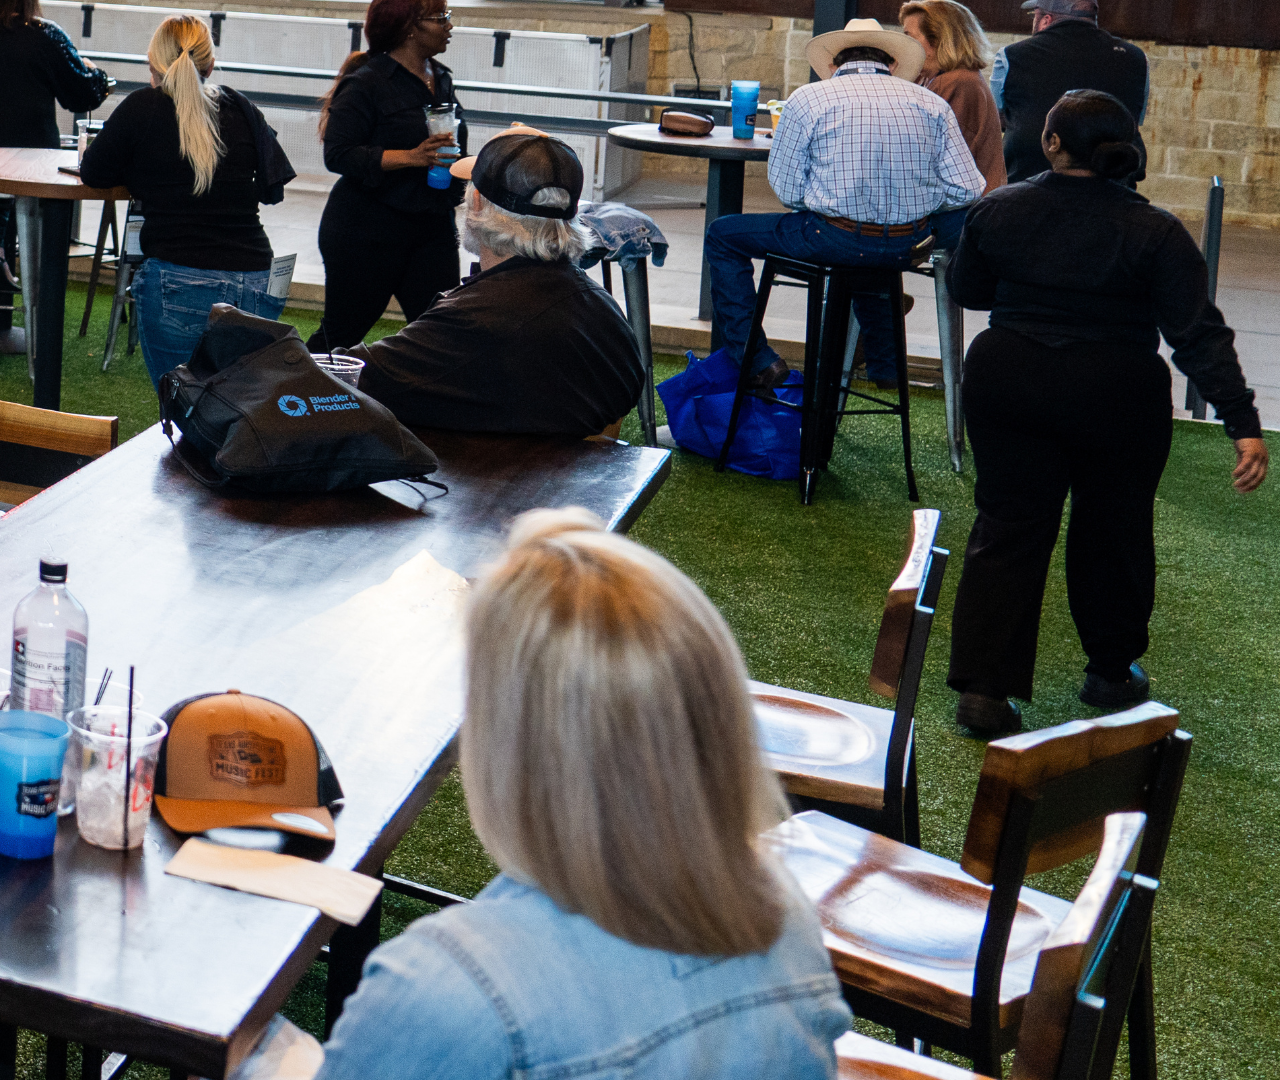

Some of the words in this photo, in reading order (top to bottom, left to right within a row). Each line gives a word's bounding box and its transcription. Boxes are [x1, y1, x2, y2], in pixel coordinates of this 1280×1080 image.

[309, 394, 349, 404] Blender
[313, 402, 360, 412] Products
[216, 762, 251, 779] MUSIC
